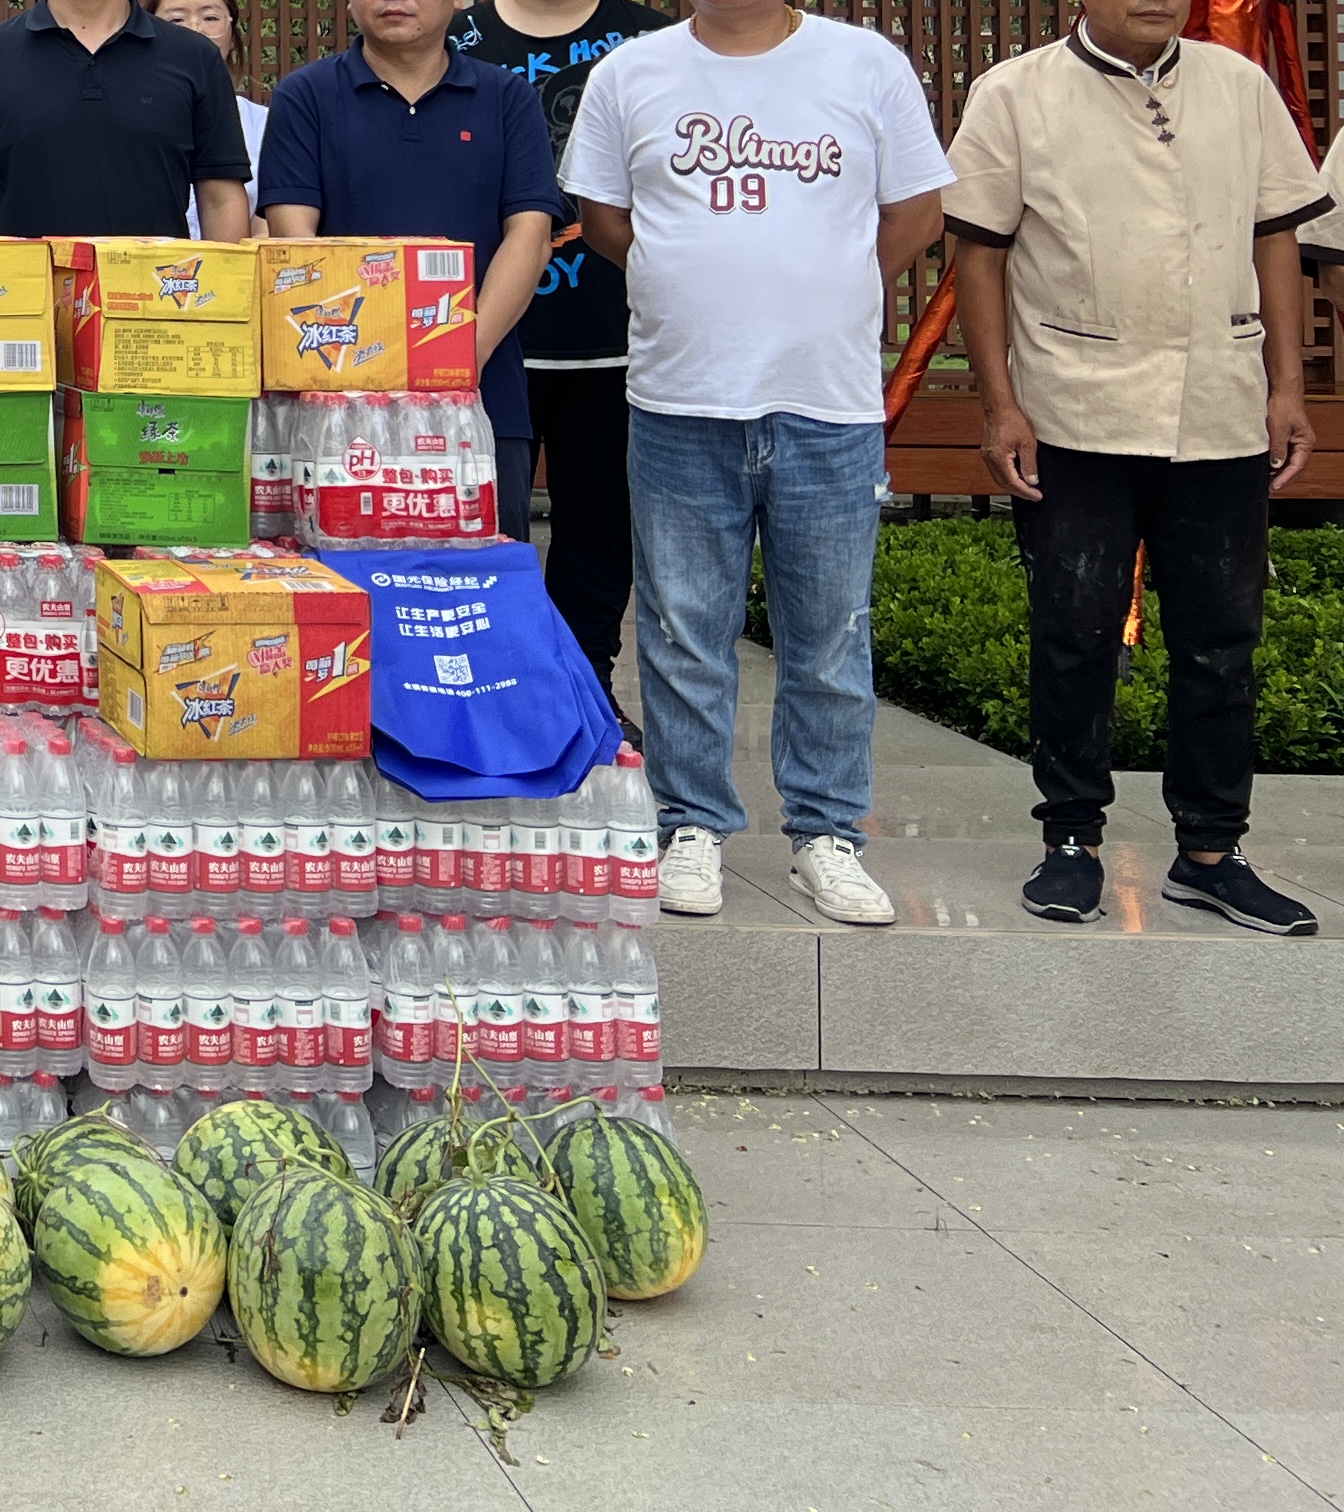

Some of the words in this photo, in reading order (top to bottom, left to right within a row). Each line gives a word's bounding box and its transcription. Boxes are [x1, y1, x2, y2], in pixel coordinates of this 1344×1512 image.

[709, 173, 769, 215] 09
[298, 324, 358, 355] 冰红茶
[141, 421, 179, 442] 绿茶
[349, 451, 375, 471] pH
[382, 492, 456, 518] 更优惠
[5, 657, 80, 683] 更优惠
[183, 698, 235, 725] 冰红茶
